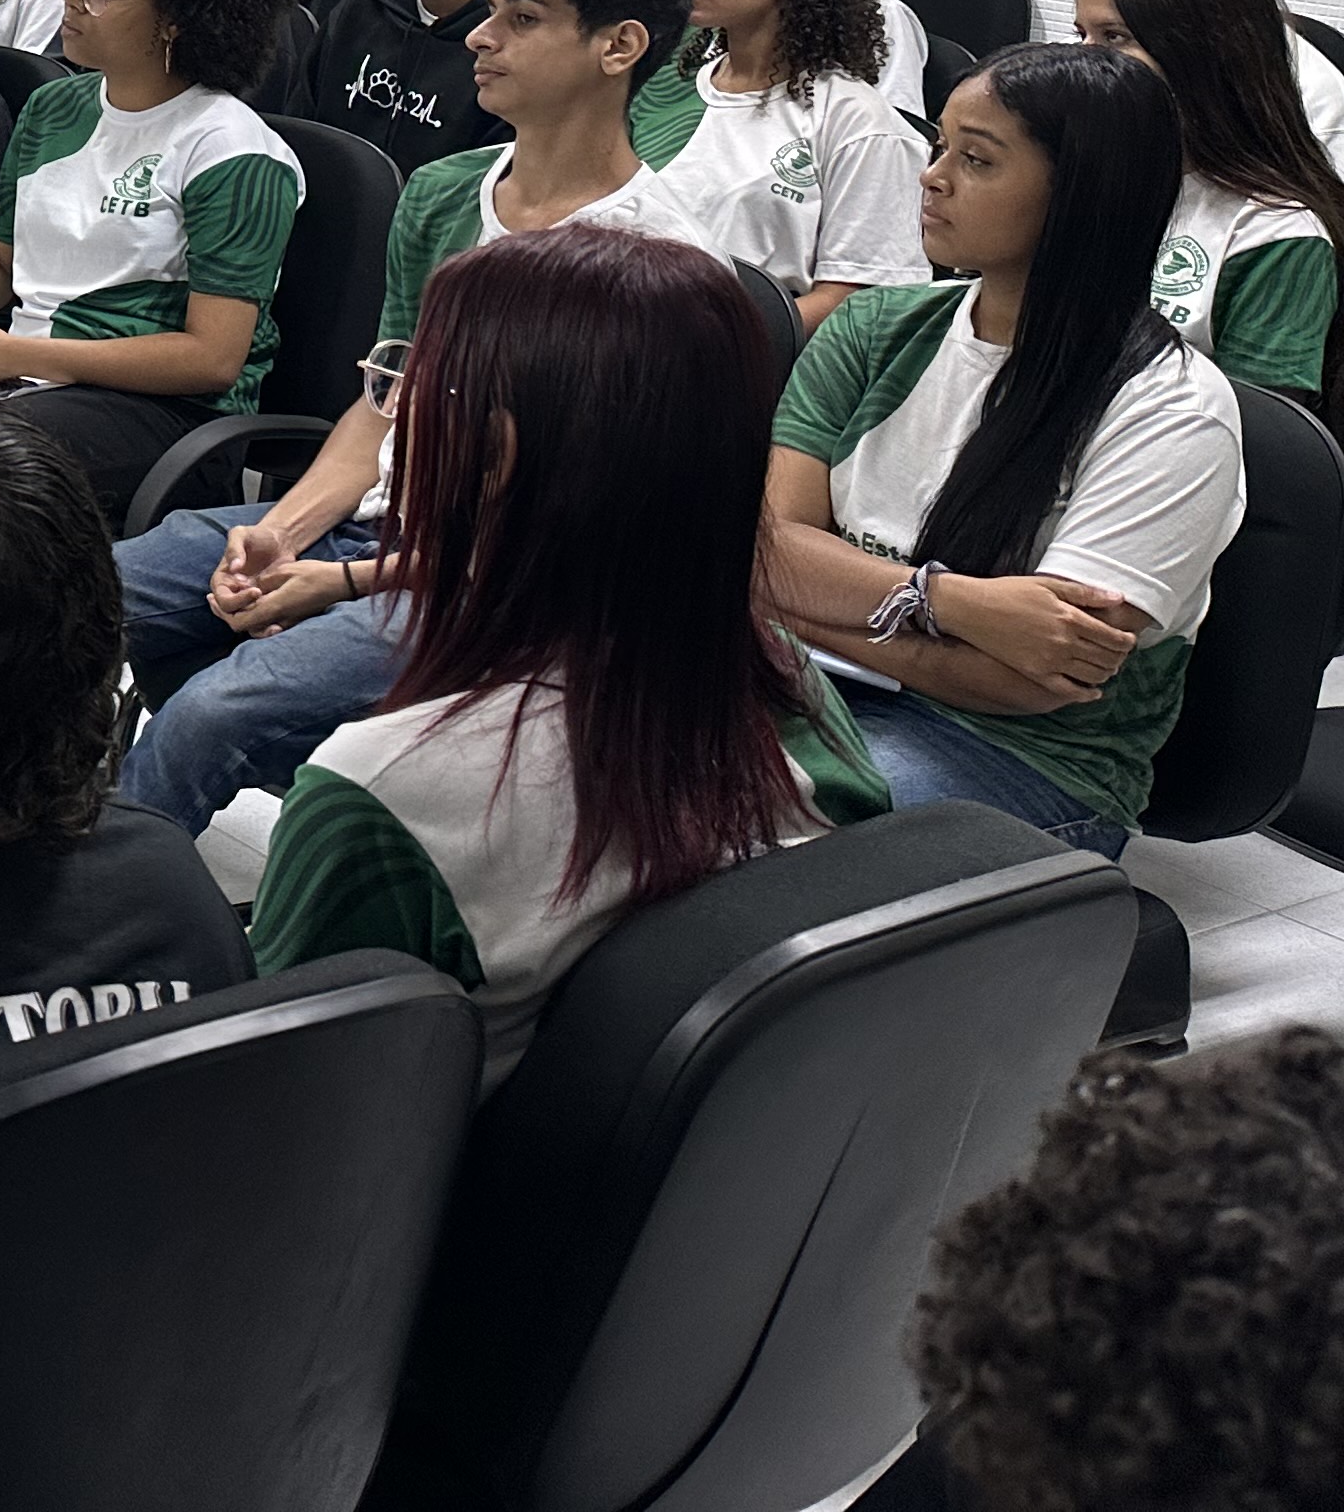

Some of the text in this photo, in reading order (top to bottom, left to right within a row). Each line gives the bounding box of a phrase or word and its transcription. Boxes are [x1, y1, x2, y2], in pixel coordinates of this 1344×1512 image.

[771, 182, 805, 204] CETB
[100, 195, 150, 218] CETB
[1153, 296, 1191, 324] TB
